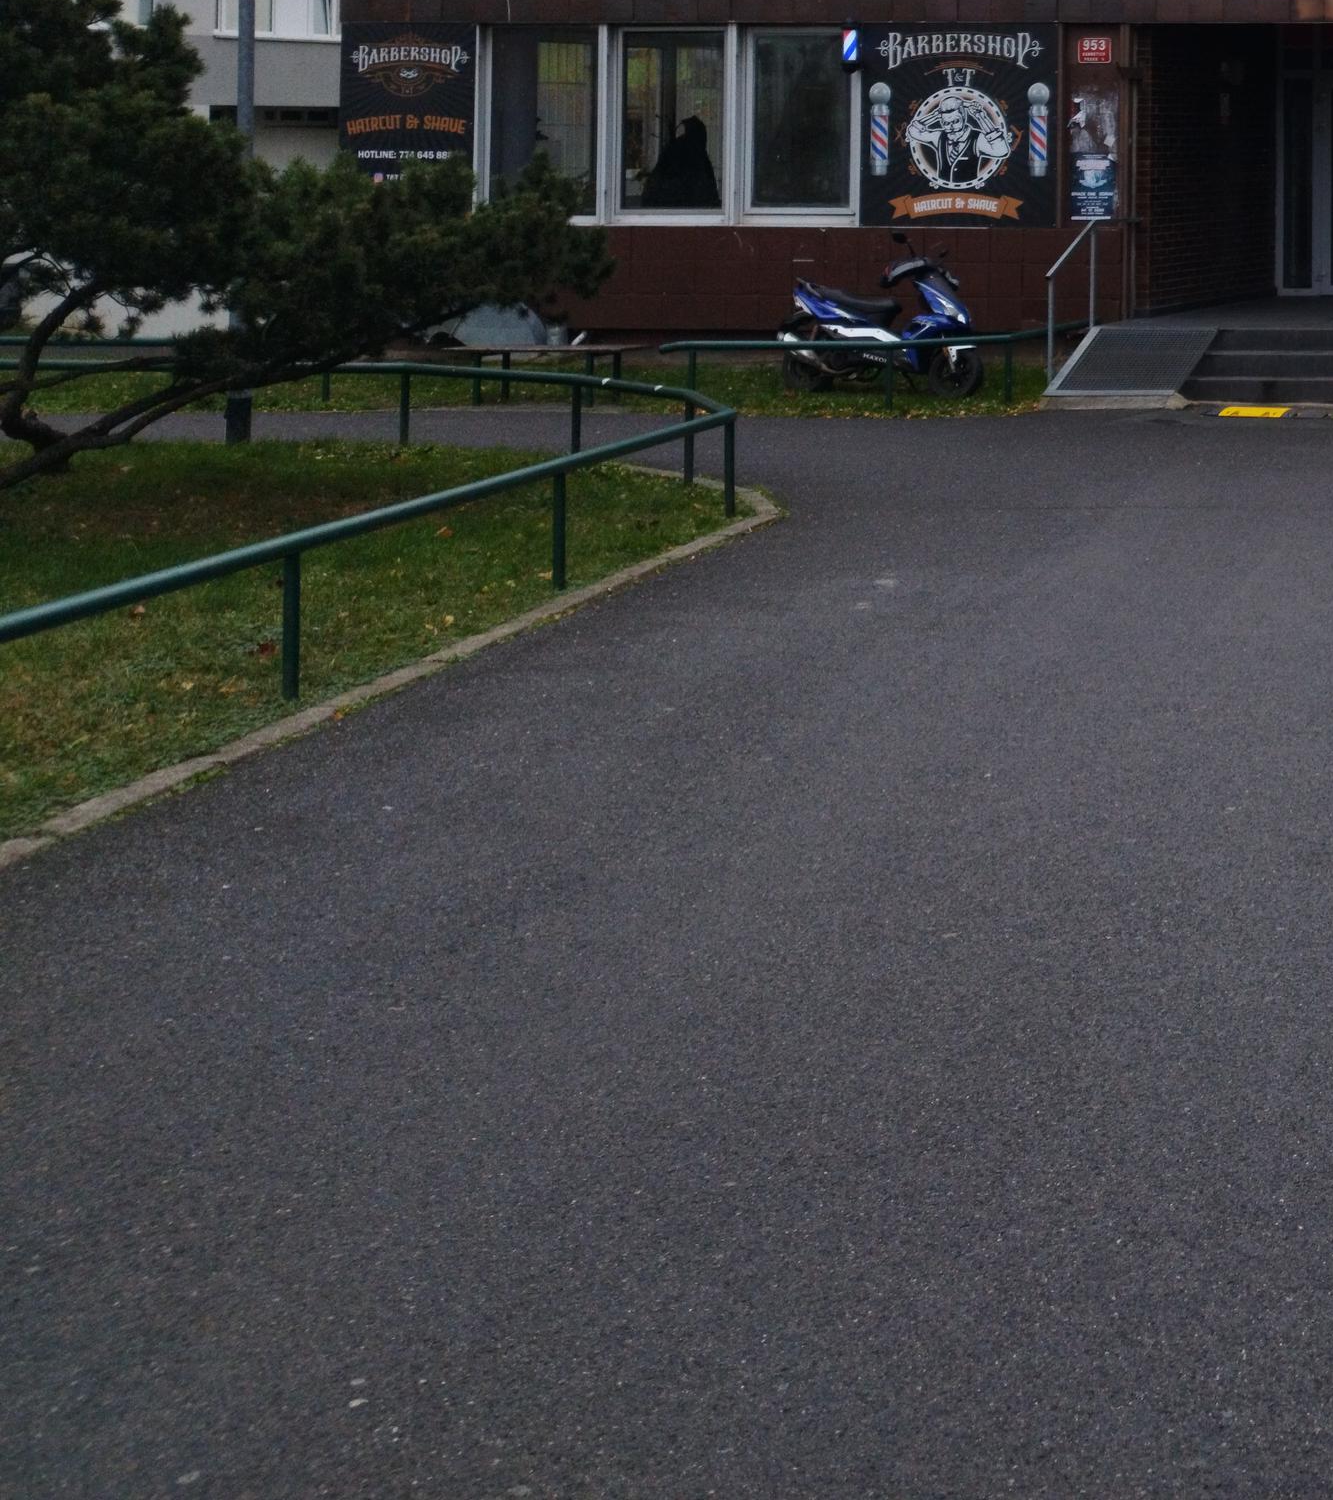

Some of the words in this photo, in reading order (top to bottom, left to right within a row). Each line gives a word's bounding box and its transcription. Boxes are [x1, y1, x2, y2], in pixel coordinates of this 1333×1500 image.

[887, 31, 1032, 70] BARBERSHOP
[1082, 39, 1106, 51] 953
[357, 44, 462, 73] BARBERSHOP
[941, 67, 976, 88] T&T
[346, 114, 402, 136] HAIRCUT
[406, 114, 420, 130] &
[357, 150, 397, 160] HOTLINE:
[416, 150, 435, 160] 645
[913, 197, 952, 214] HAIRCUT
